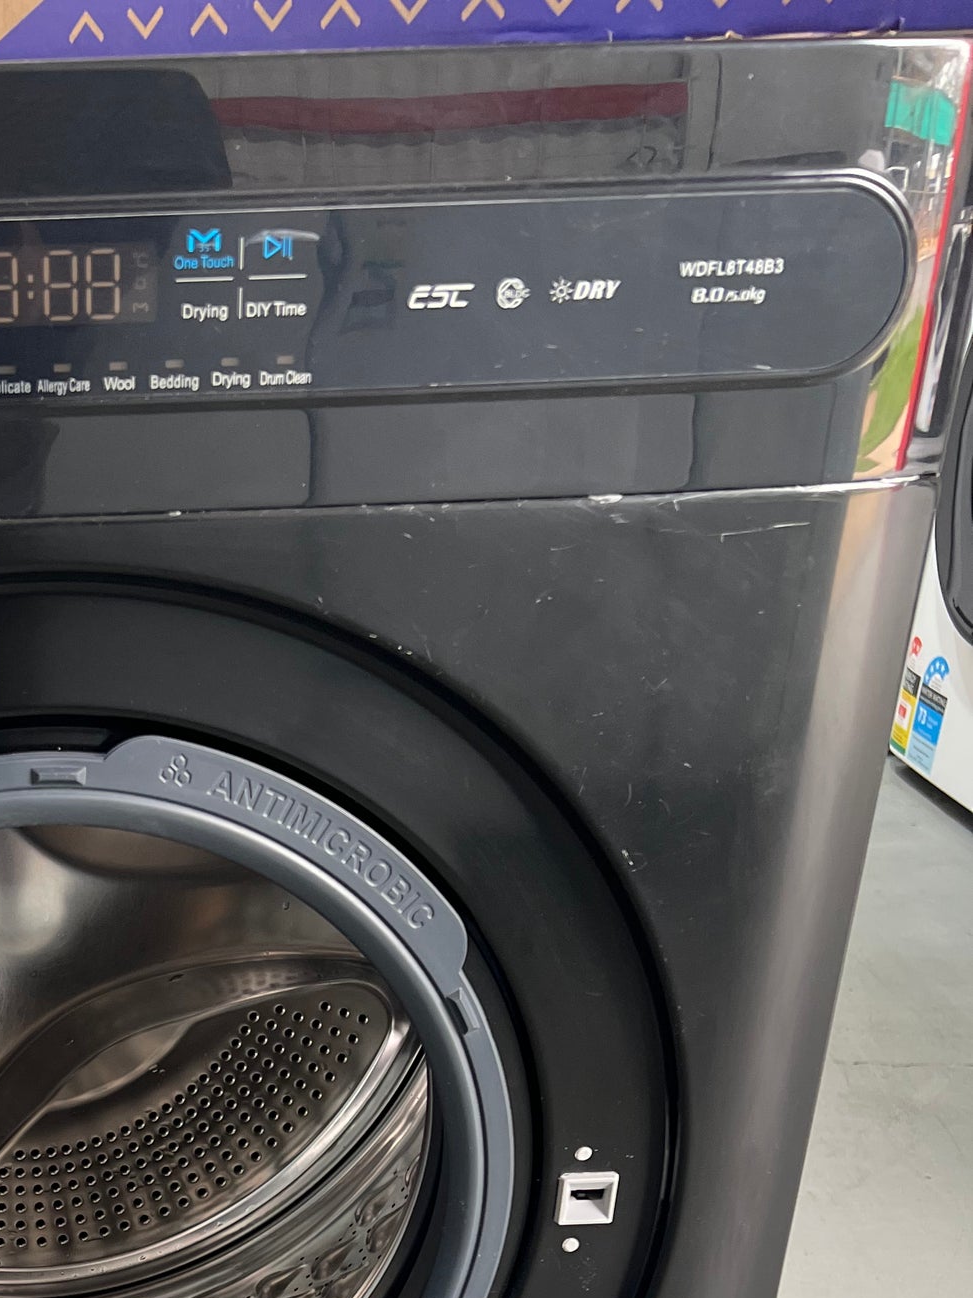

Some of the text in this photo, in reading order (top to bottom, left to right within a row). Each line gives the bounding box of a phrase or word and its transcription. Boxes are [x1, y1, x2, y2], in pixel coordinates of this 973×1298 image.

[174, 254, 234, 270] One Touch
[679, 257, 785, 277] WDFL8T48B3
[408, 283, 475, 309] ESC
[574, 280, 621, 300] DRY
[182, 303, 229, 322] Drying
[246, 301, 307, 318] DIY Time
[37, 378, 91, 396] Allergy Care
[104, 376, 136, 391] Wool
[150, 375, 200, 392] Bedding
[212, 371, 251, 389] Drying
[260, 370, 312, 386] Drum Clean
[206, 770, 435, 930] ANTIMICROBIC
